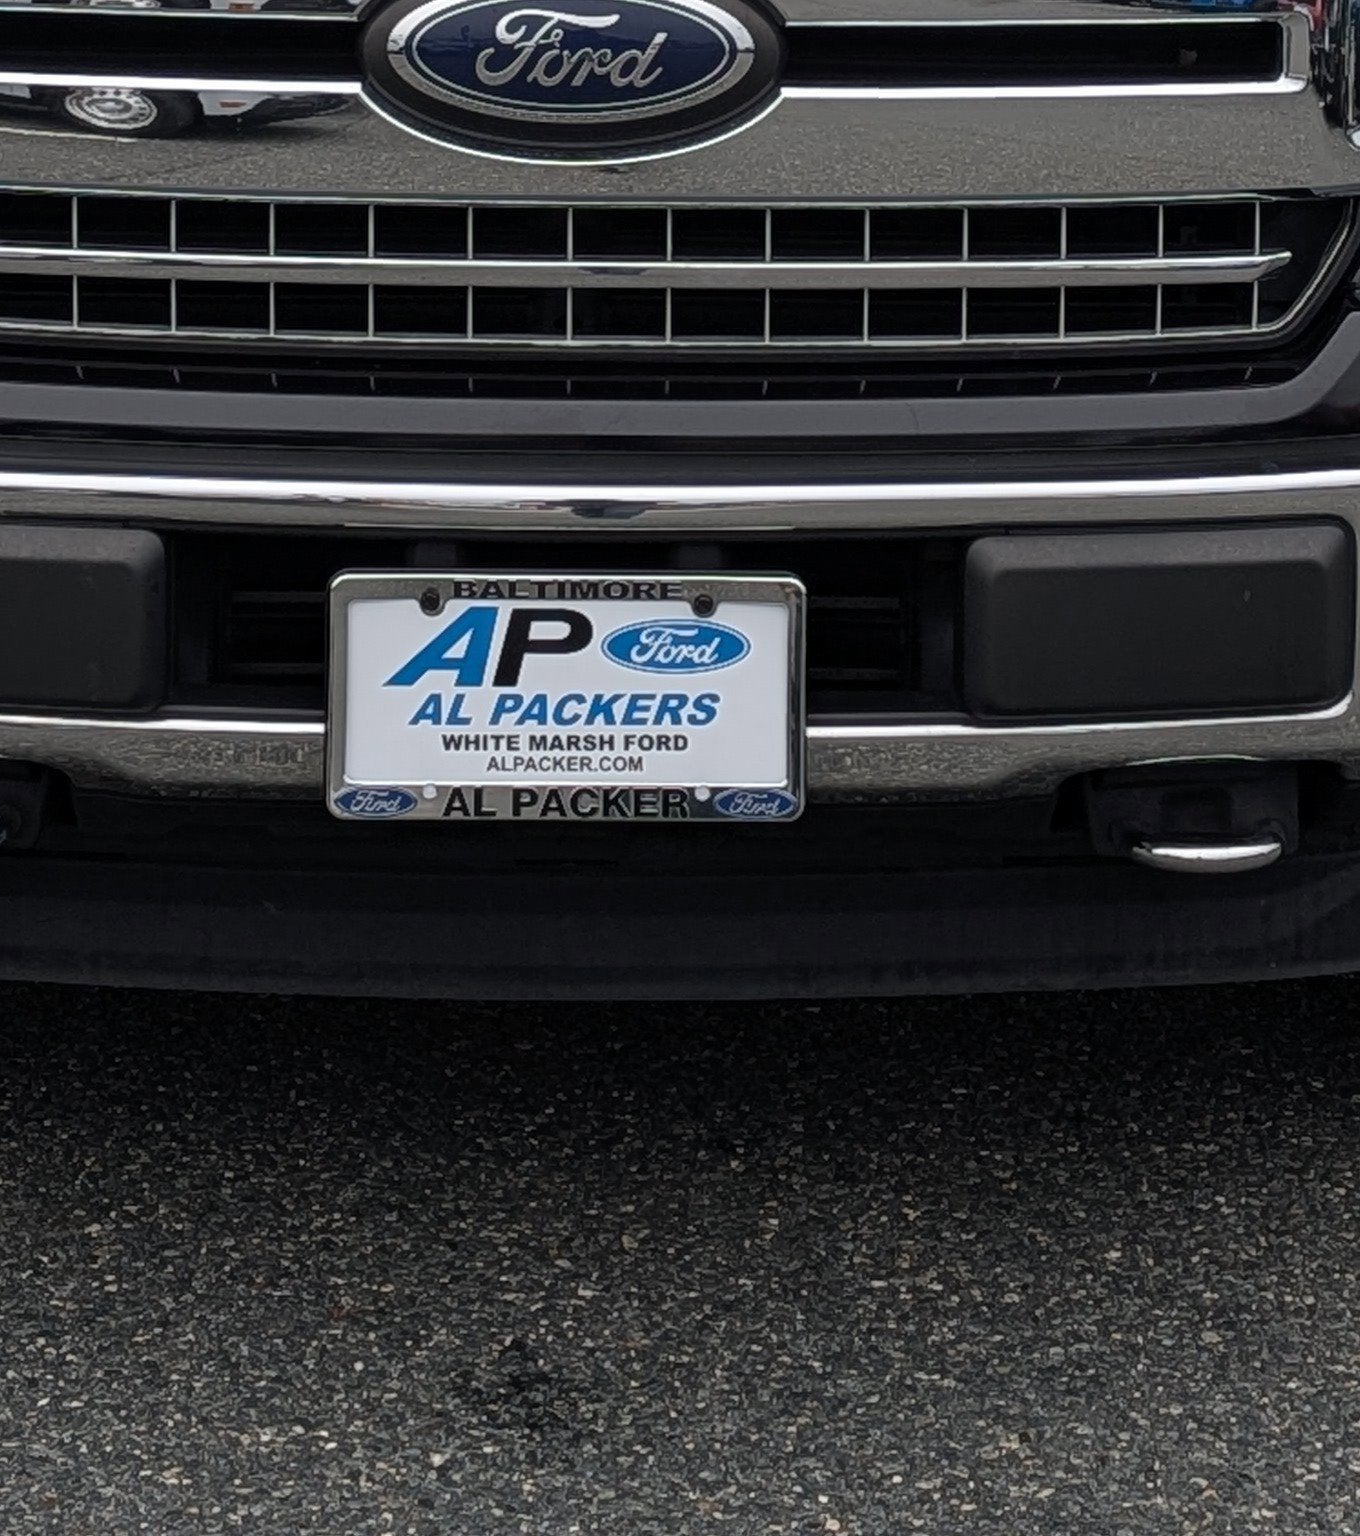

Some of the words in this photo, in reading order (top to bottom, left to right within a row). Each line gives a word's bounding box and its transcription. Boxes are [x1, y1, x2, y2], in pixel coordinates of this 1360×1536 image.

[476, 9, 668, 87] Ford
[452, 580, 683, 600] BALTIMORE
[382, 606, 594, 688] AP
[630, 626, 721, 664] Ford
[408, 693, 473, 726] AL
[489, 693, 722, 727] PACKERS
[441, 734, 521, 752] WHITE
[528, 734, 615, 752] MARSH
[623, 734, 689, 752] FORD
[486, 756, 644, 773] ALPACKER.COM
[349, 789, 401, 813] Ford
[442, 787, 498, 817] AL
[511, 786, 689, 818] PACKER
[728, 792, 780, 815] Ford
